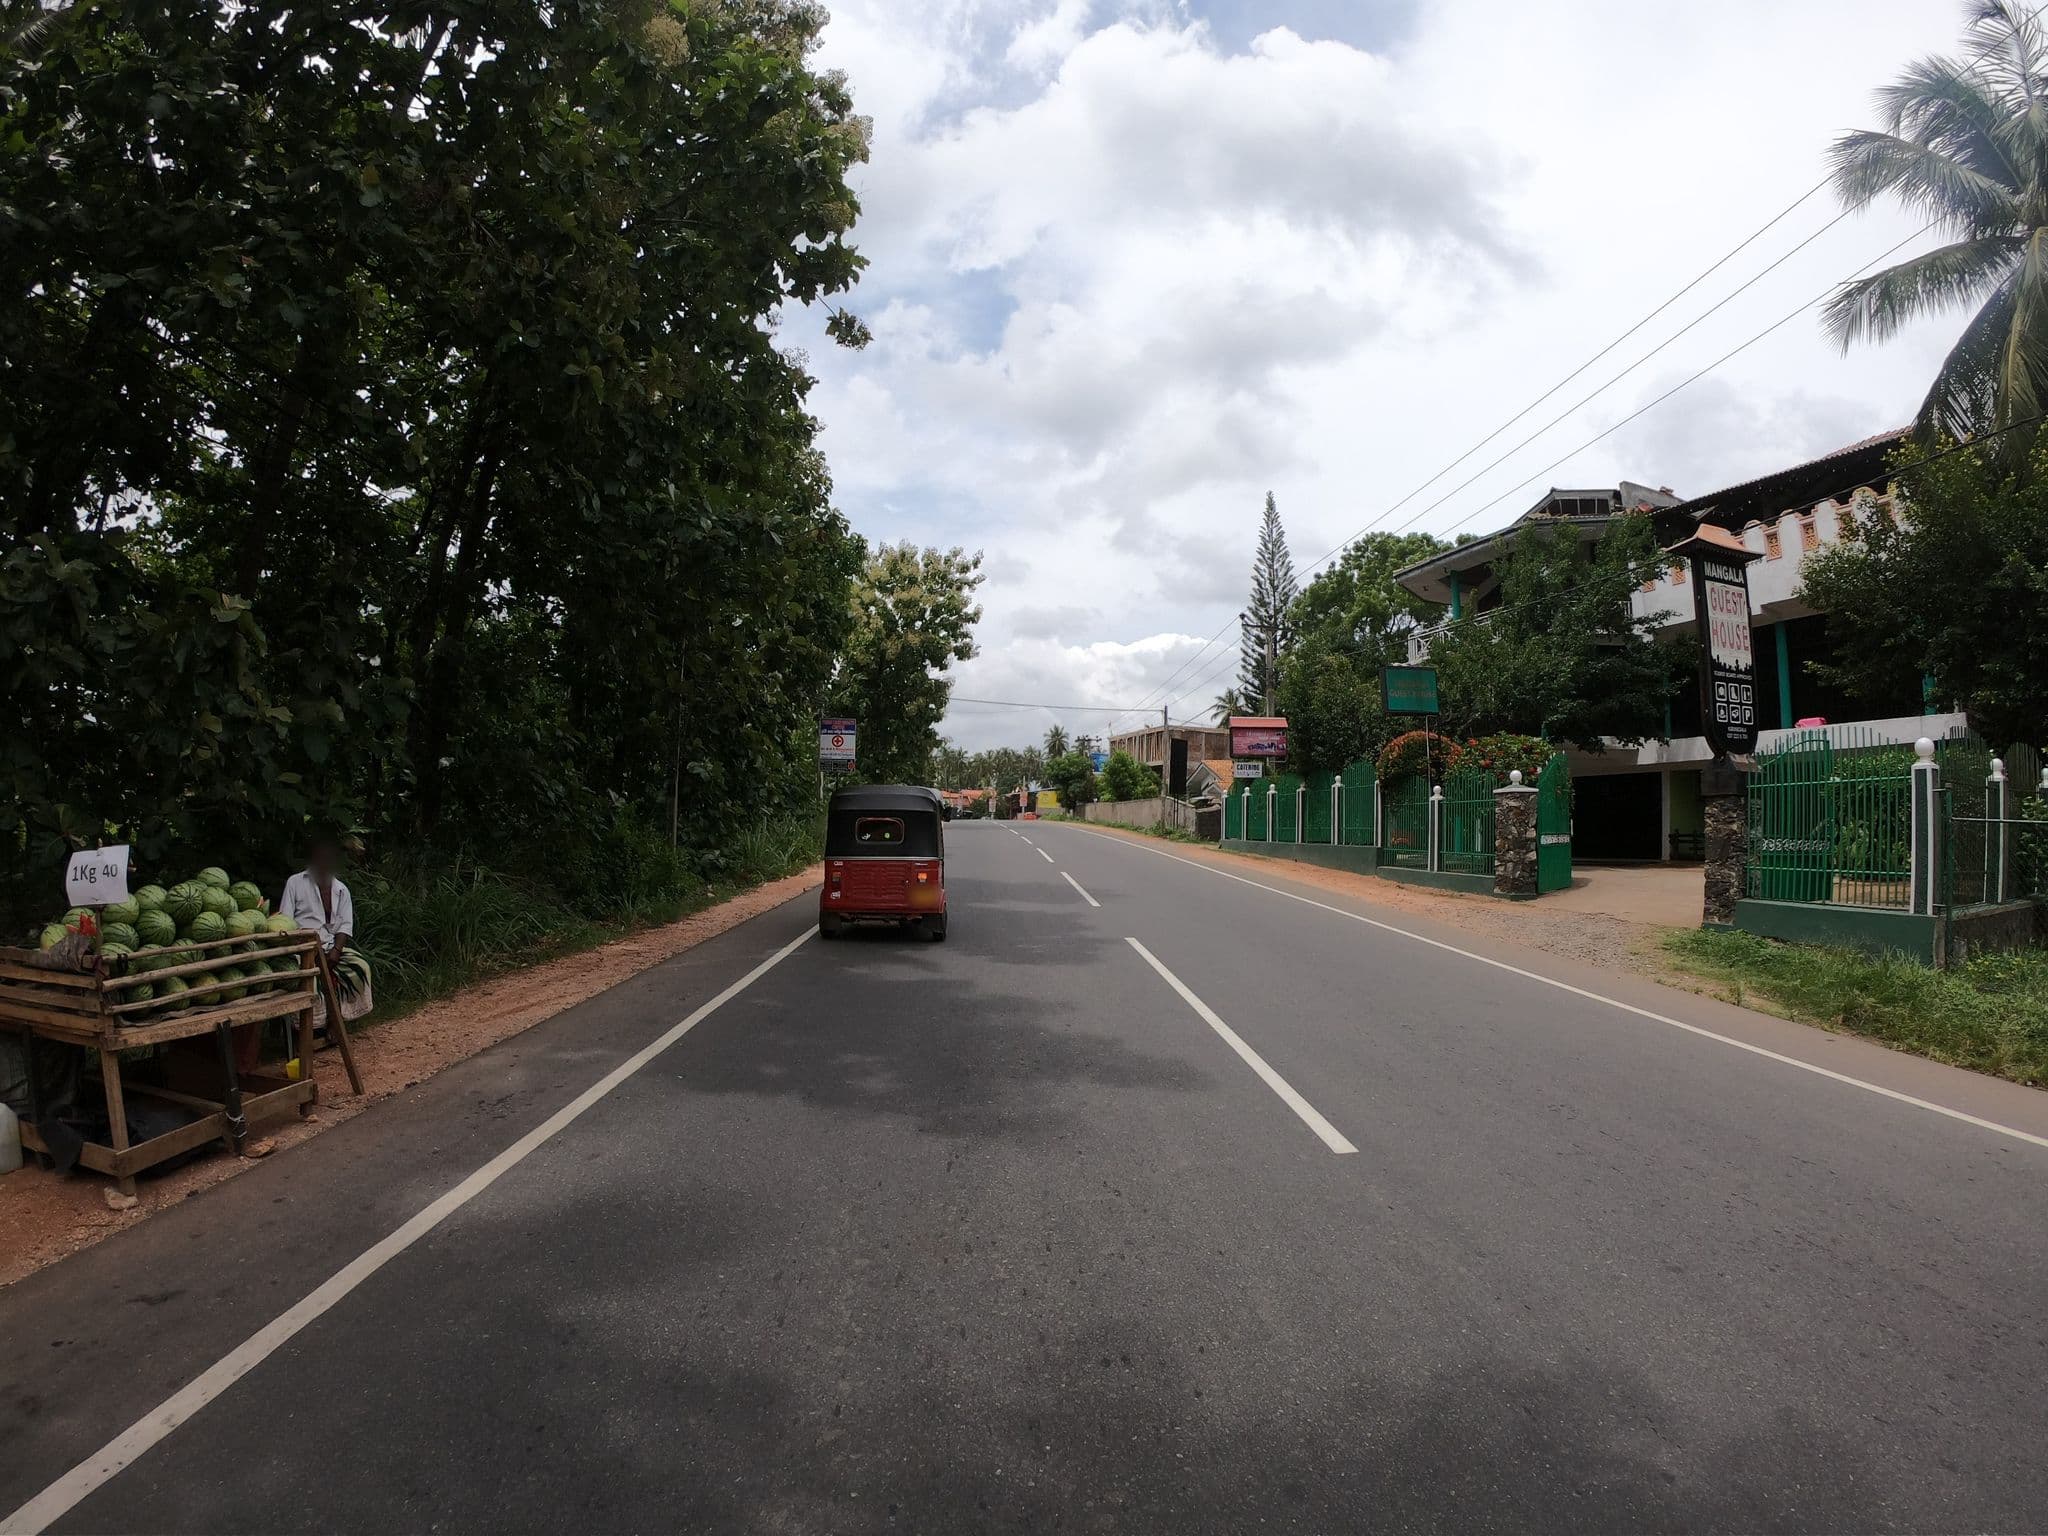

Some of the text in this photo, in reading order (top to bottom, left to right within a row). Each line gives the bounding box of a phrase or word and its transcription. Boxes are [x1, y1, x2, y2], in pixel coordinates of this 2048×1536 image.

[1703, 561, 1744, 584] MANGALA
[1710, 586, 1745, 618] GUEST
[1711, 622, 1750, 651] HOUSE
[72, 864, 118, 884] 1Kg 40
